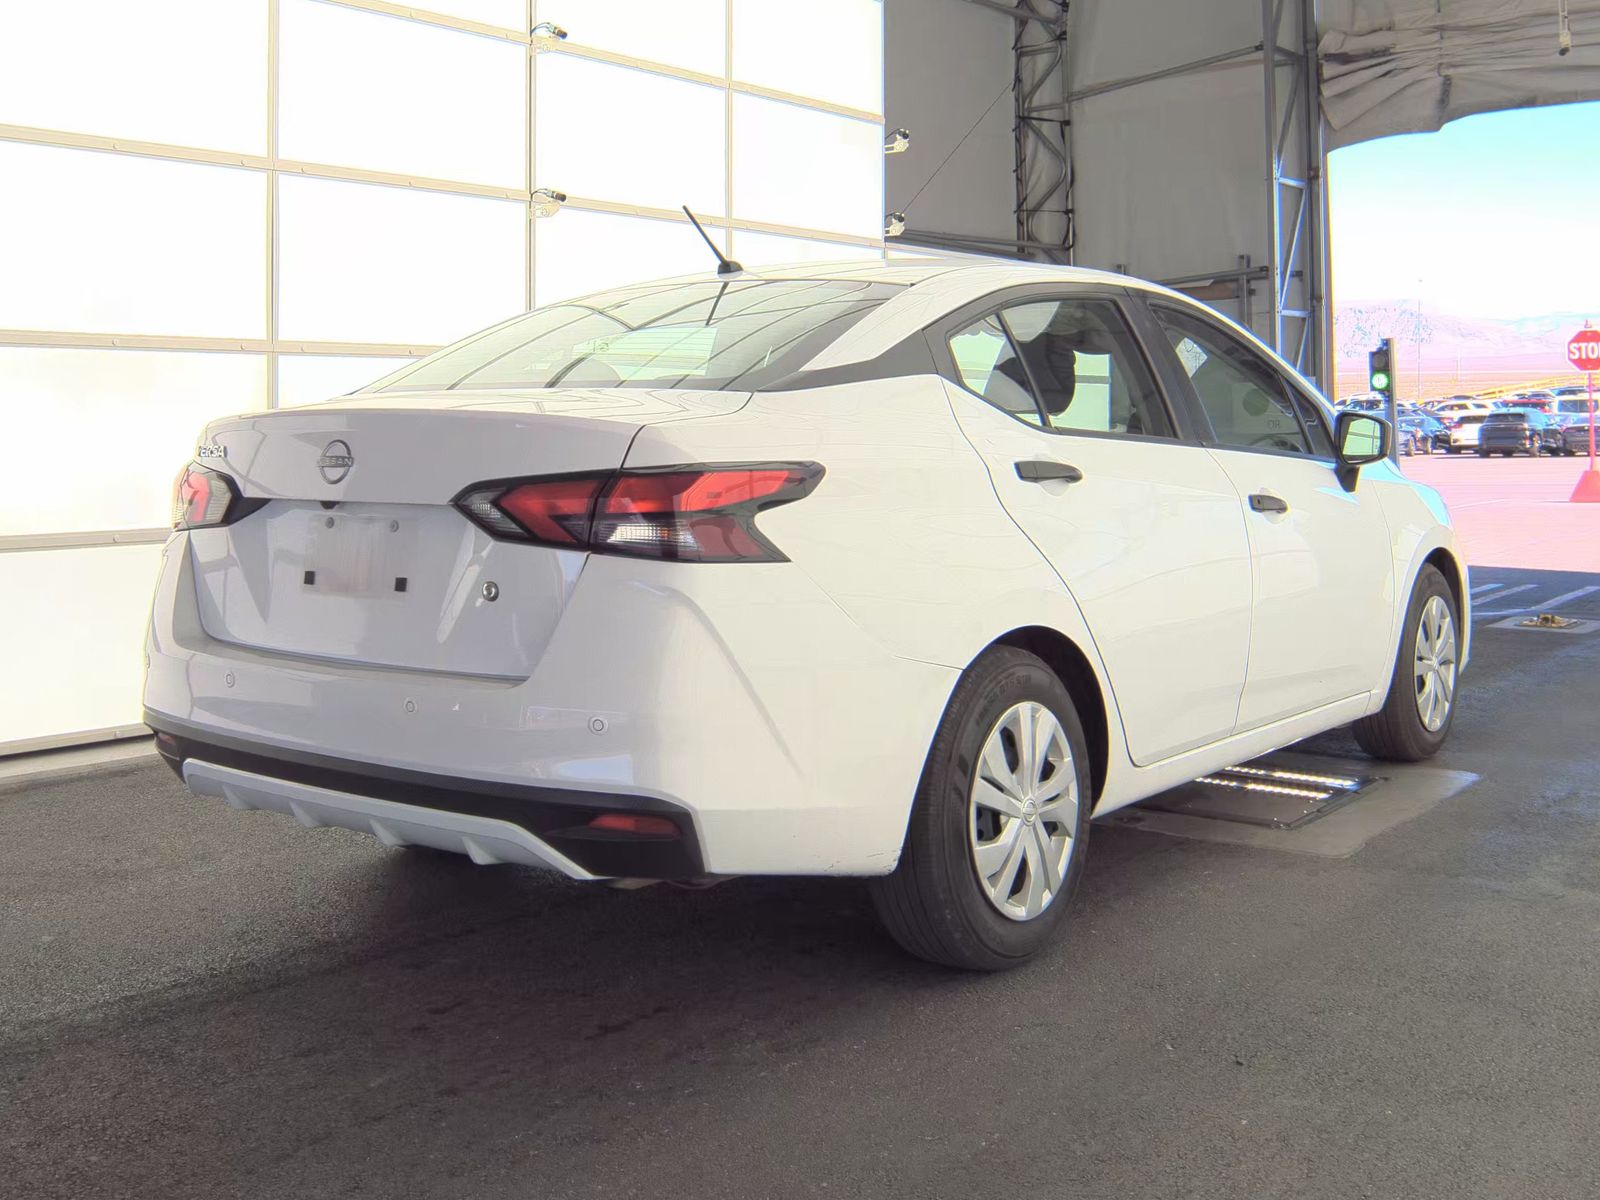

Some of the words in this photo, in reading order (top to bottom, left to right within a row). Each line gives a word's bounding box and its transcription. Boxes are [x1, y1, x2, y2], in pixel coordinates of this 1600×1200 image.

[1569, 342, 1600, 360] STO
[198, 445, 226, 458] ERSA
[317, 456, 353, 467] SSAN
